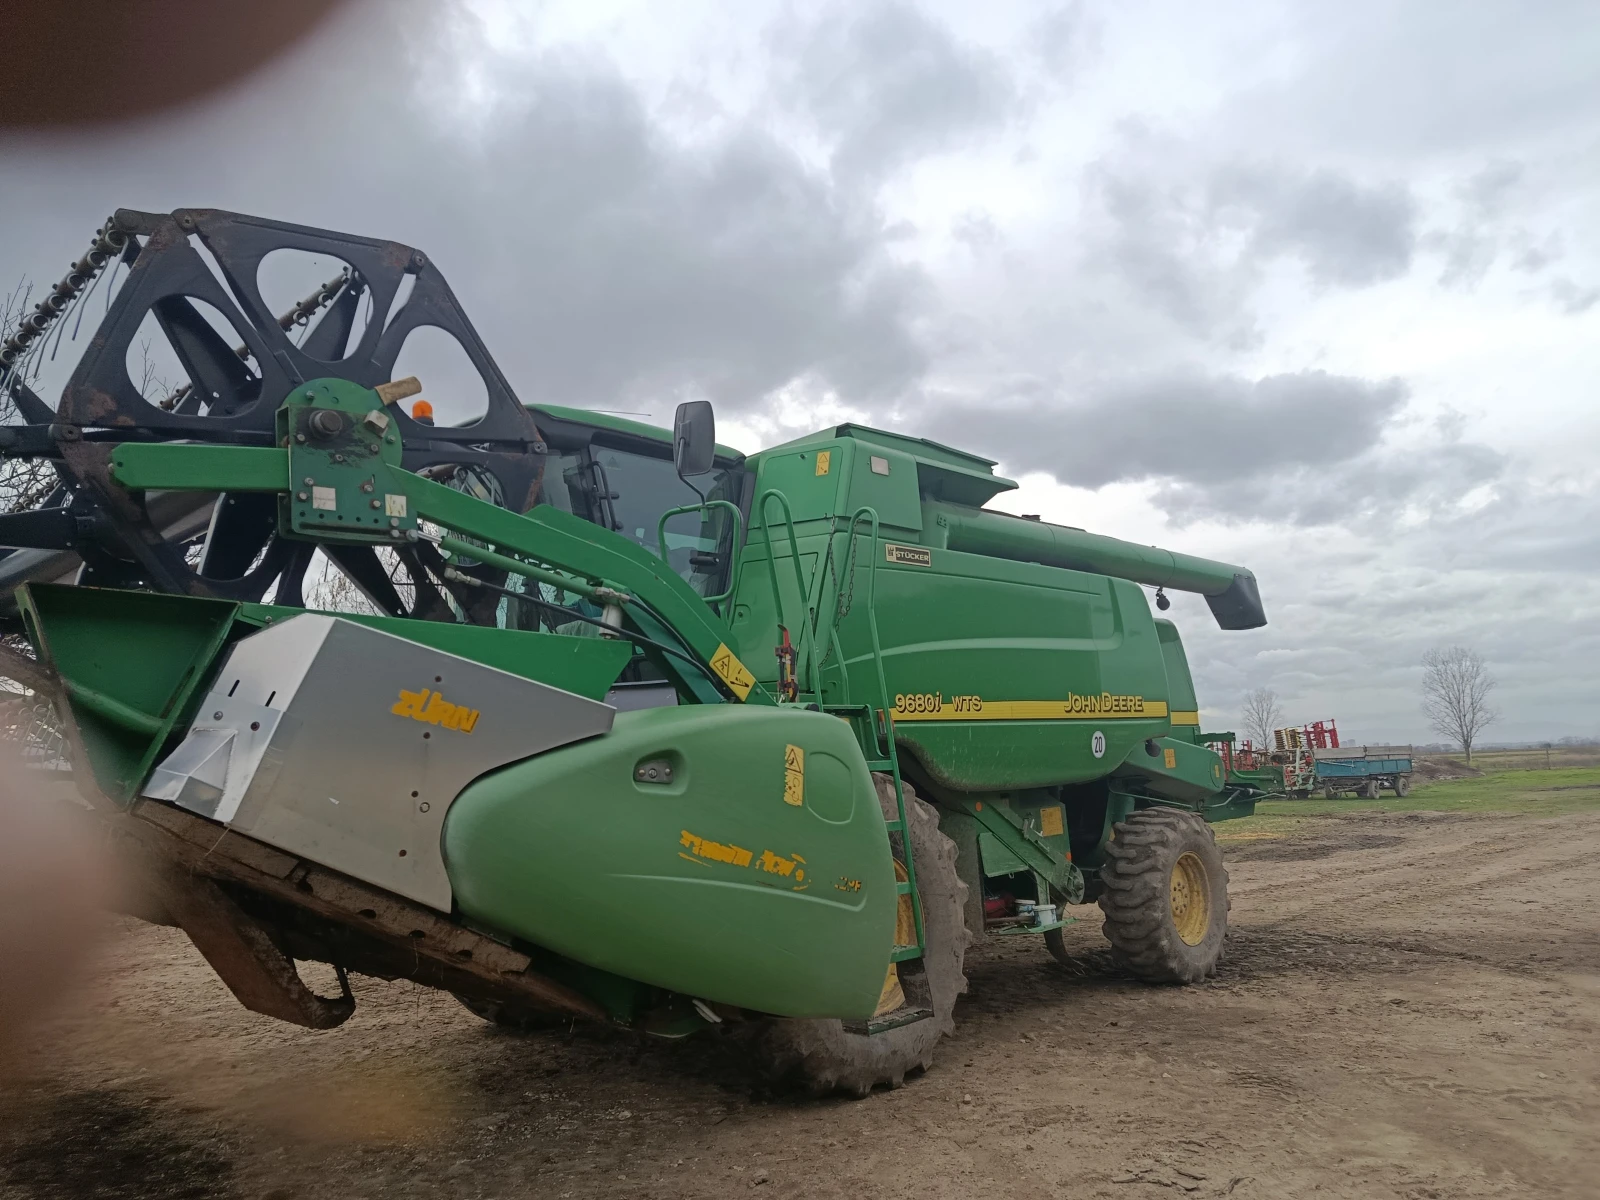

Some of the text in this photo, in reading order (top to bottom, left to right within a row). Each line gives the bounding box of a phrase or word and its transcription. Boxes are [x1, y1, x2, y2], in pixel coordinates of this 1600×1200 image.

[896, 551, 929, 562] STÜCKER
[895, 691, 983, 713] 9680i WTS
[1064, 691, 1144, 713] JOHN DEERE
[1094, 736, 1104, 754] 20
